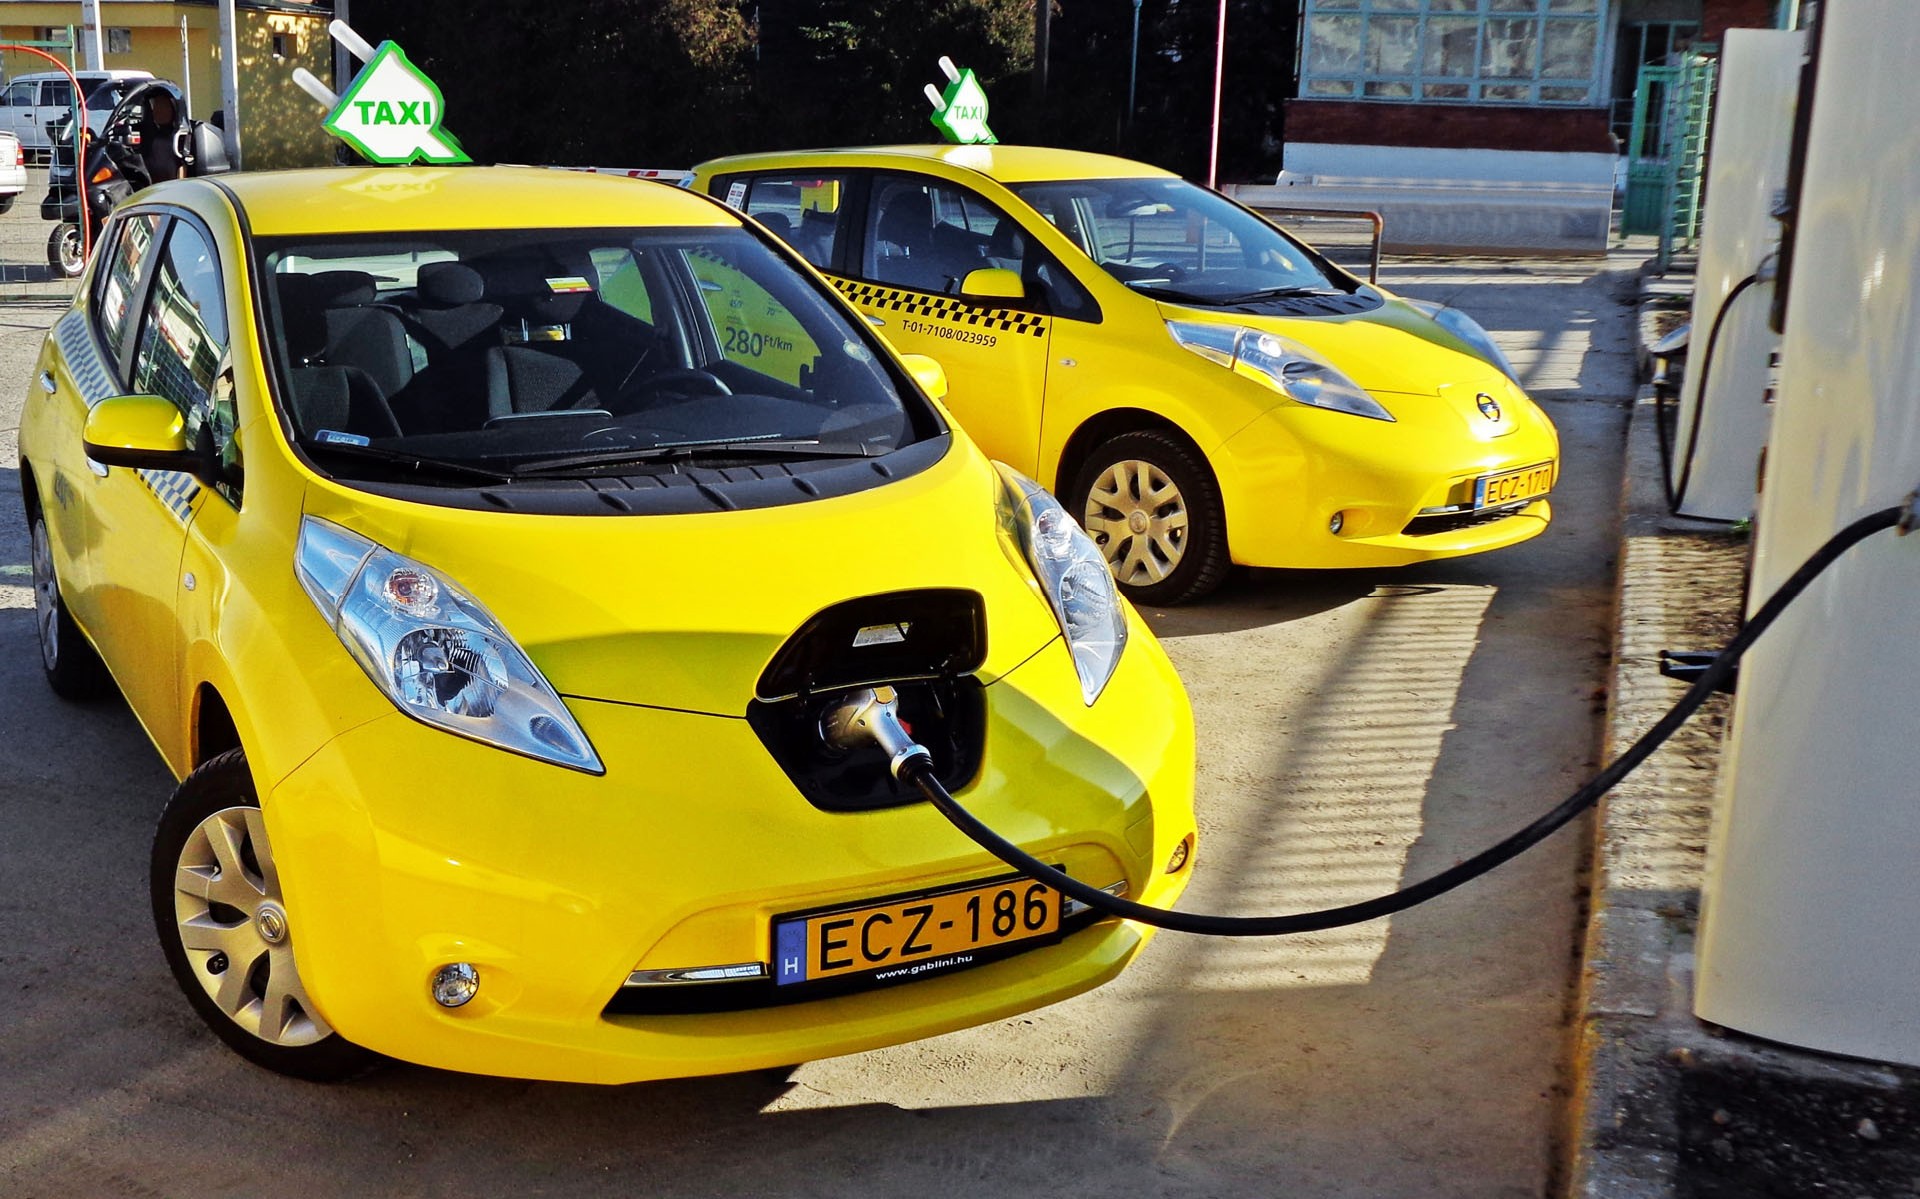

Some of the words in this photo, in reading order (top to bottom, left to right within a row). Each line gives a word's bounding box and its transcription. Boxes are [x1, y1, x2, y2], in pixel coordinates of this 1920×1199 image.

[354, 101, 431, 125] TAXI
[954, 105, 983, 120] TAXI
[724, 326, 763, 357] 280
[764, 335, 793, 352] Ft/km
[902, 319, 997, 347] T-01-7108/023959
[1487, 468, 1549, 504] ECZ-170
[820, 883, 1048, 971] ECZ-186
[784, 957, 799, 975] H
[876, 955, 973, 980] www.gablini.hu
